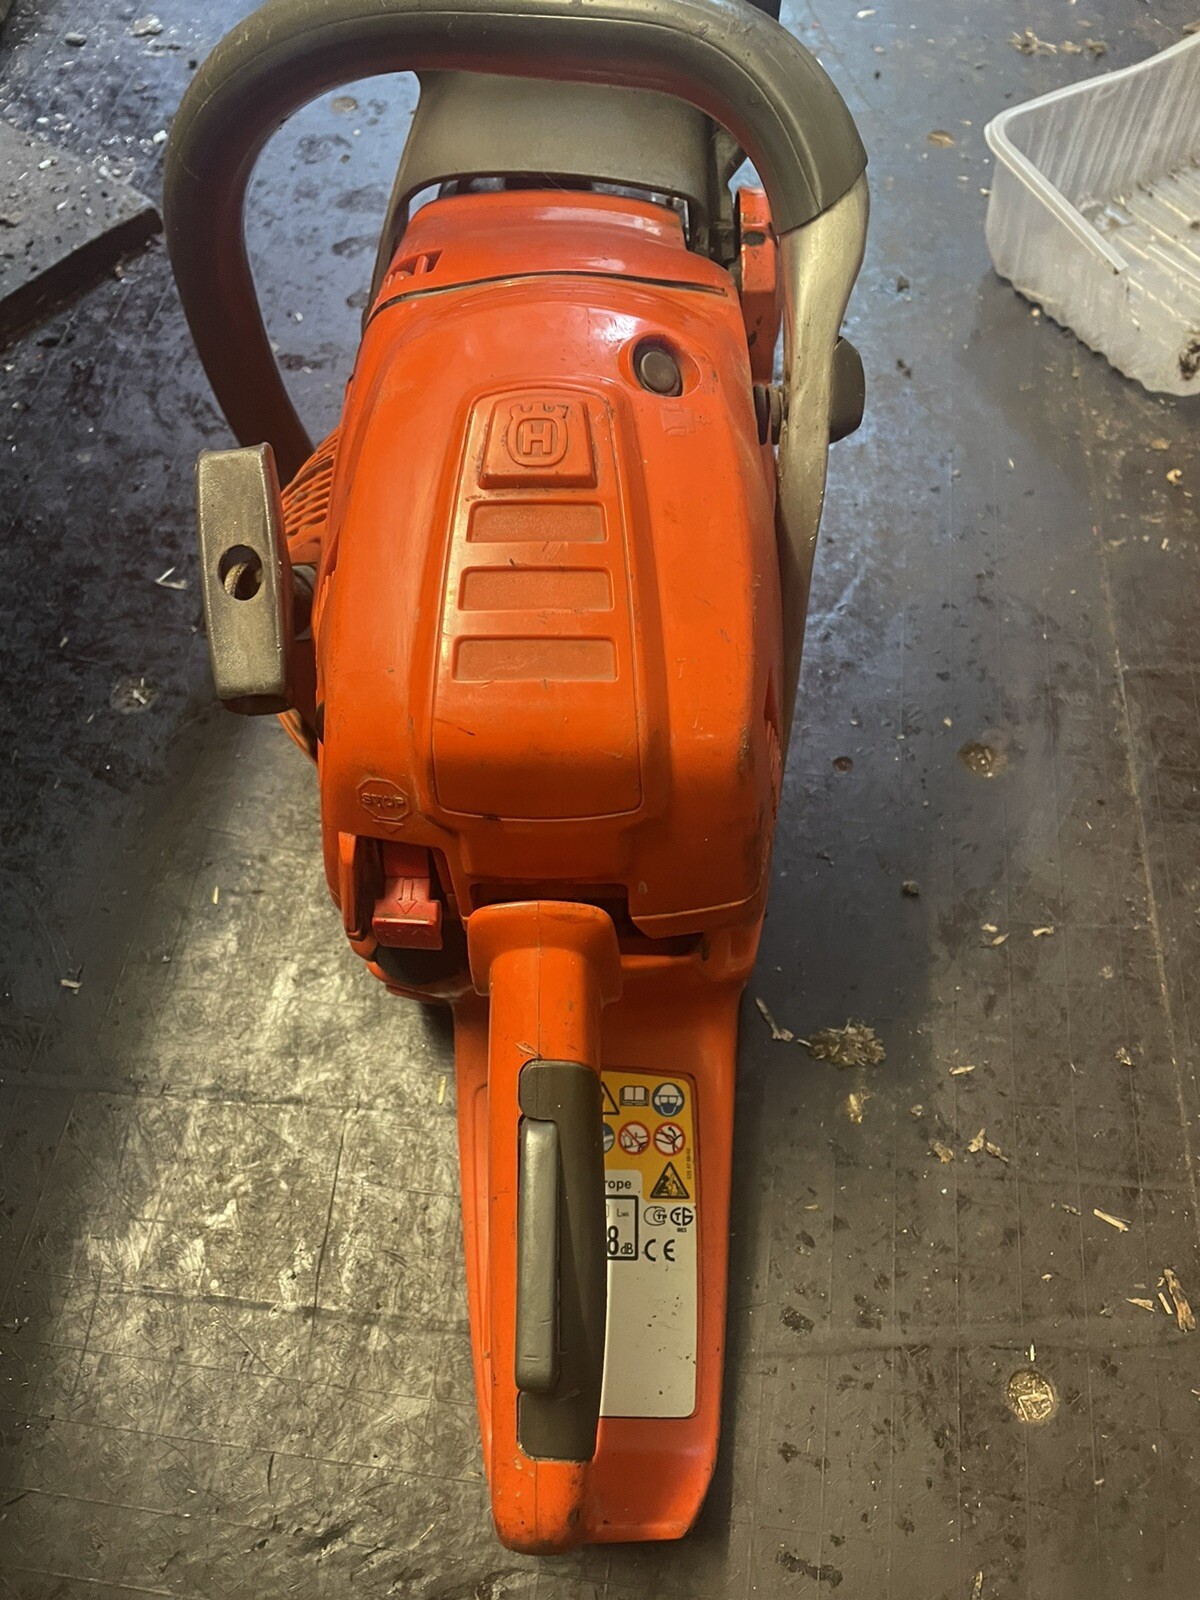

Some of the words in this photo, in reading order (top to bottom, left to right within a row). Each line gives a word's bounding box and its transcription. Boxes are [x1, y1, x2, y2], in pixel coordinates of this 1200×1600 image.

[522, 422, 553, 455] H
[620, 1242, 634, 1255] dB
[644, 1238, 676, 1262] CE
